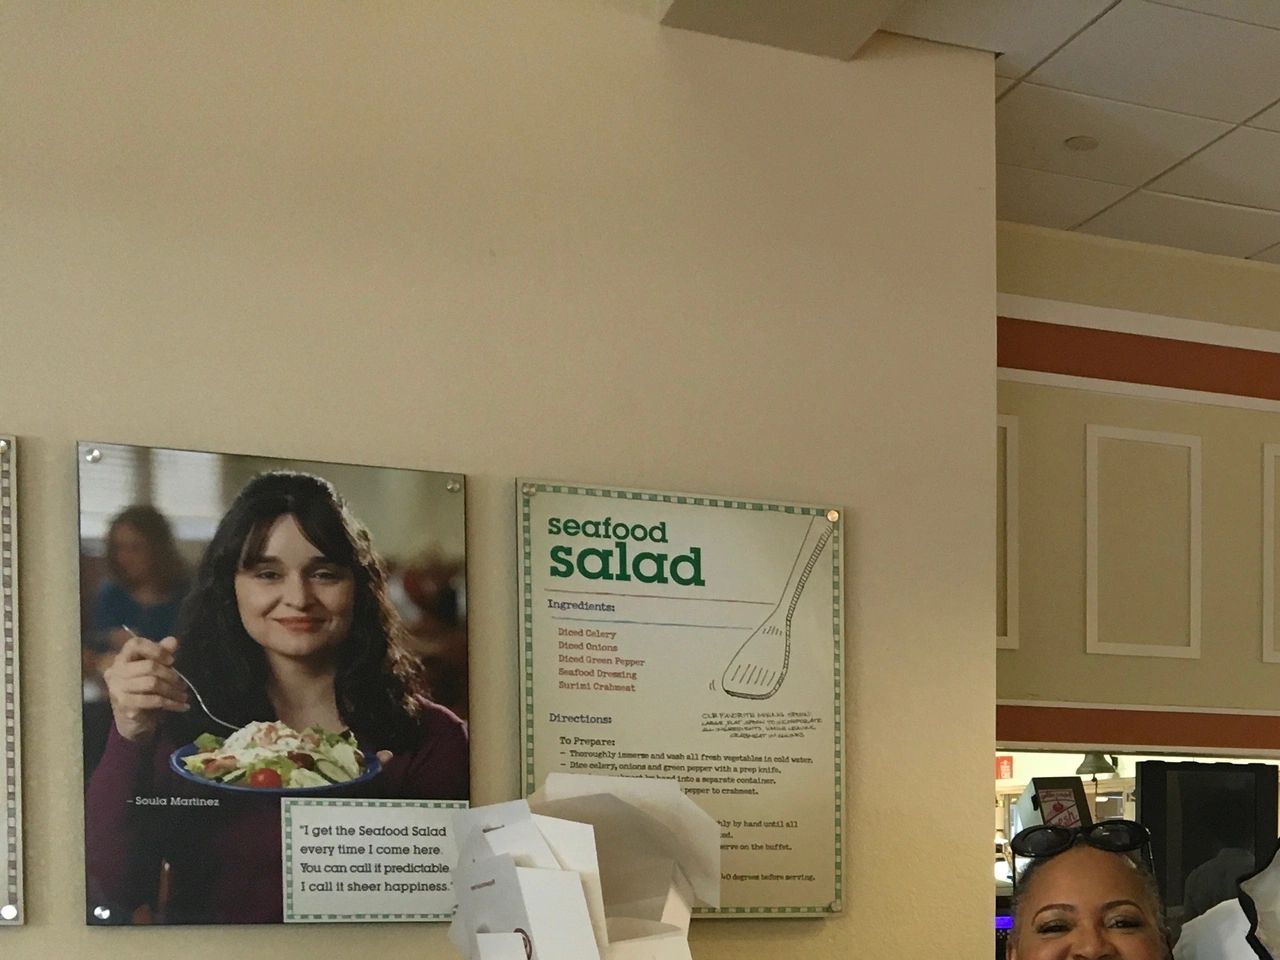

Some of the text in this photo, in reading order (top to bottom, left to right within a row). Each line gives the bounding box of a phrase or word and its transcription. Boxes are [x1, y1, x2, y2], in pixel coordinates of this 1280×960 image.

[547, 516, 669, 544] seafood
[549, 541, 706, 586] salad
[547, 598, 616, 612] Ingredients:
[558, 627, 584, 637] Diced
[558, 641, 618, 652] Diced Onions
[549, 712, 613, 724] Directions:
[559, 736, 616, 747] To Prepare:
[569, 750, 616, 760] Thoroughly
[650, 752, 665, 760] and
[686, 753, 699, 761] all
[714, 765, 732, 773] with
[136, 796, 219, 807] Soula Martinez
[743, 820, 762, 828] hand
[786, 820, 798, 828] all
[312, 826, 333, 837] get
[336, 825, 355, 836] the
[359, 825, 408, 836] Seafood
[412, 826, 447, 837] Salad
[300, 846, 335, 856] every
[338, 845, 366, 855] time
[368, 845, 373, 855] I
[376, 846, 410, 855] come
[300, 863, 321, 873] You
[324, 864, 347, 873] can
[350, 863, 372, 873] call
[374, 863, 382, 873] it
[301, 882, 305, 891] I
[309, 882, 333, 891] call
[336, 882, 344, 891] it
[347, 882, 381, 891] sheer
